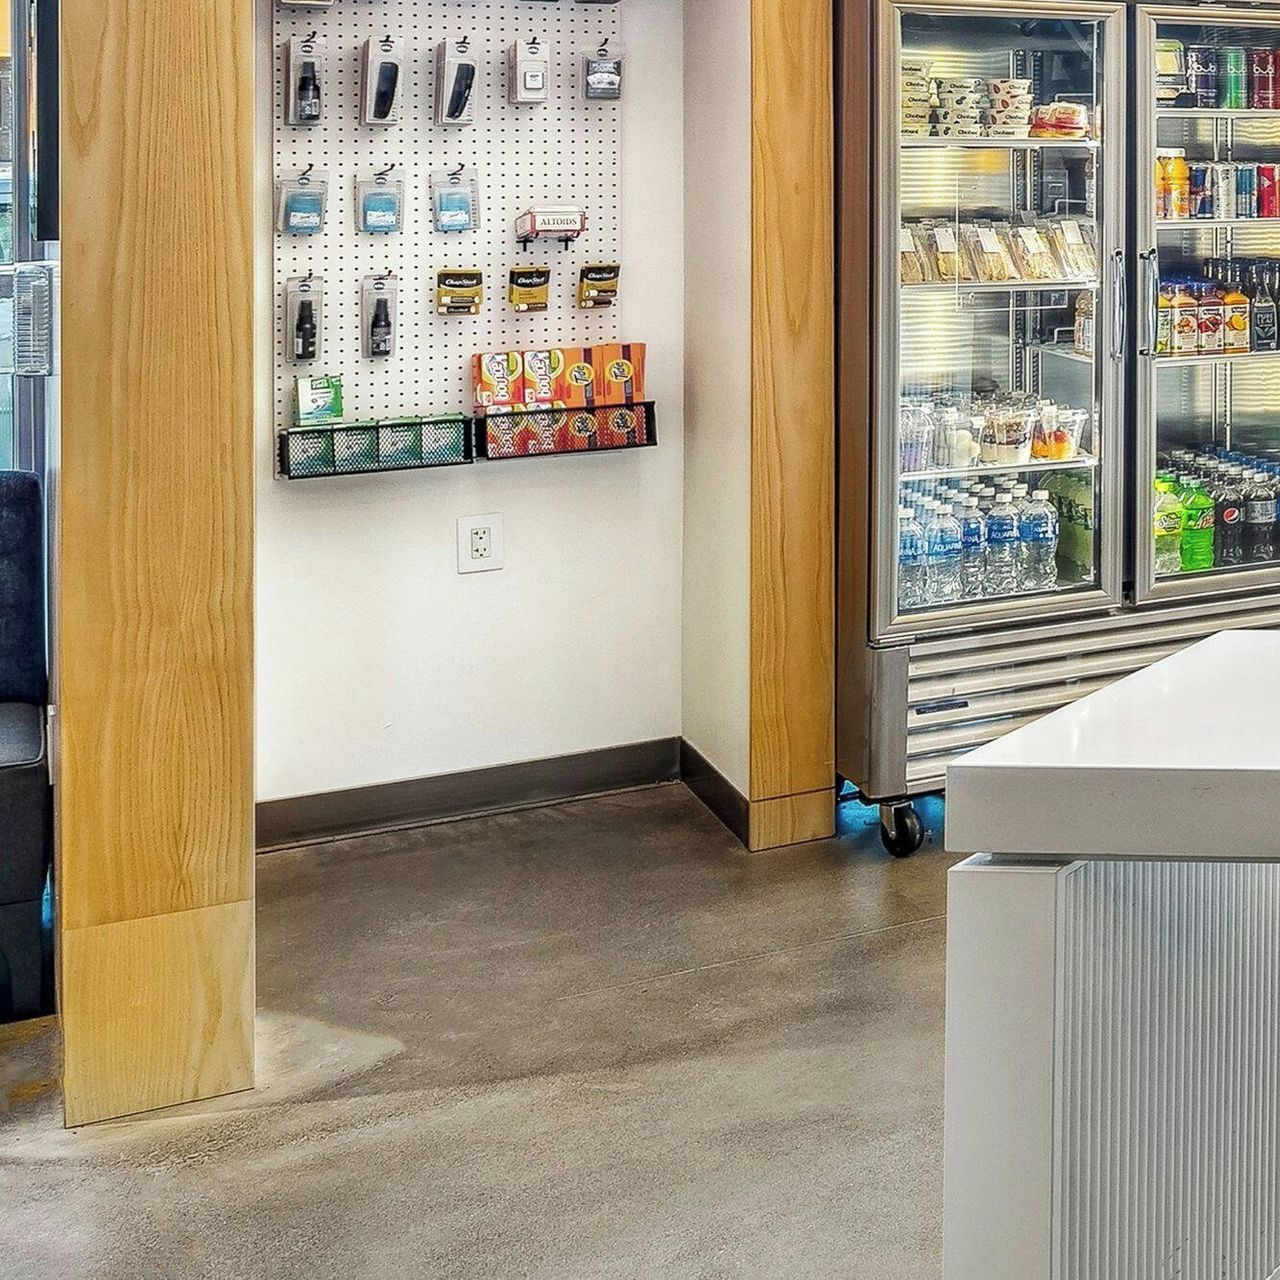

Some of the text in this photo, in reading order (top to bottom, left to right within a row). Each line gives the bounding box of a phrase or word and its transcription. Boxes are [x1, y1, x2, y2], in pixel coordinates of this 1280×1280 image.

[540, 217, 578, 226] ALTOIDS
[574, 365, 590, 383] Tide
[613, 361, 629, 380] Tide
